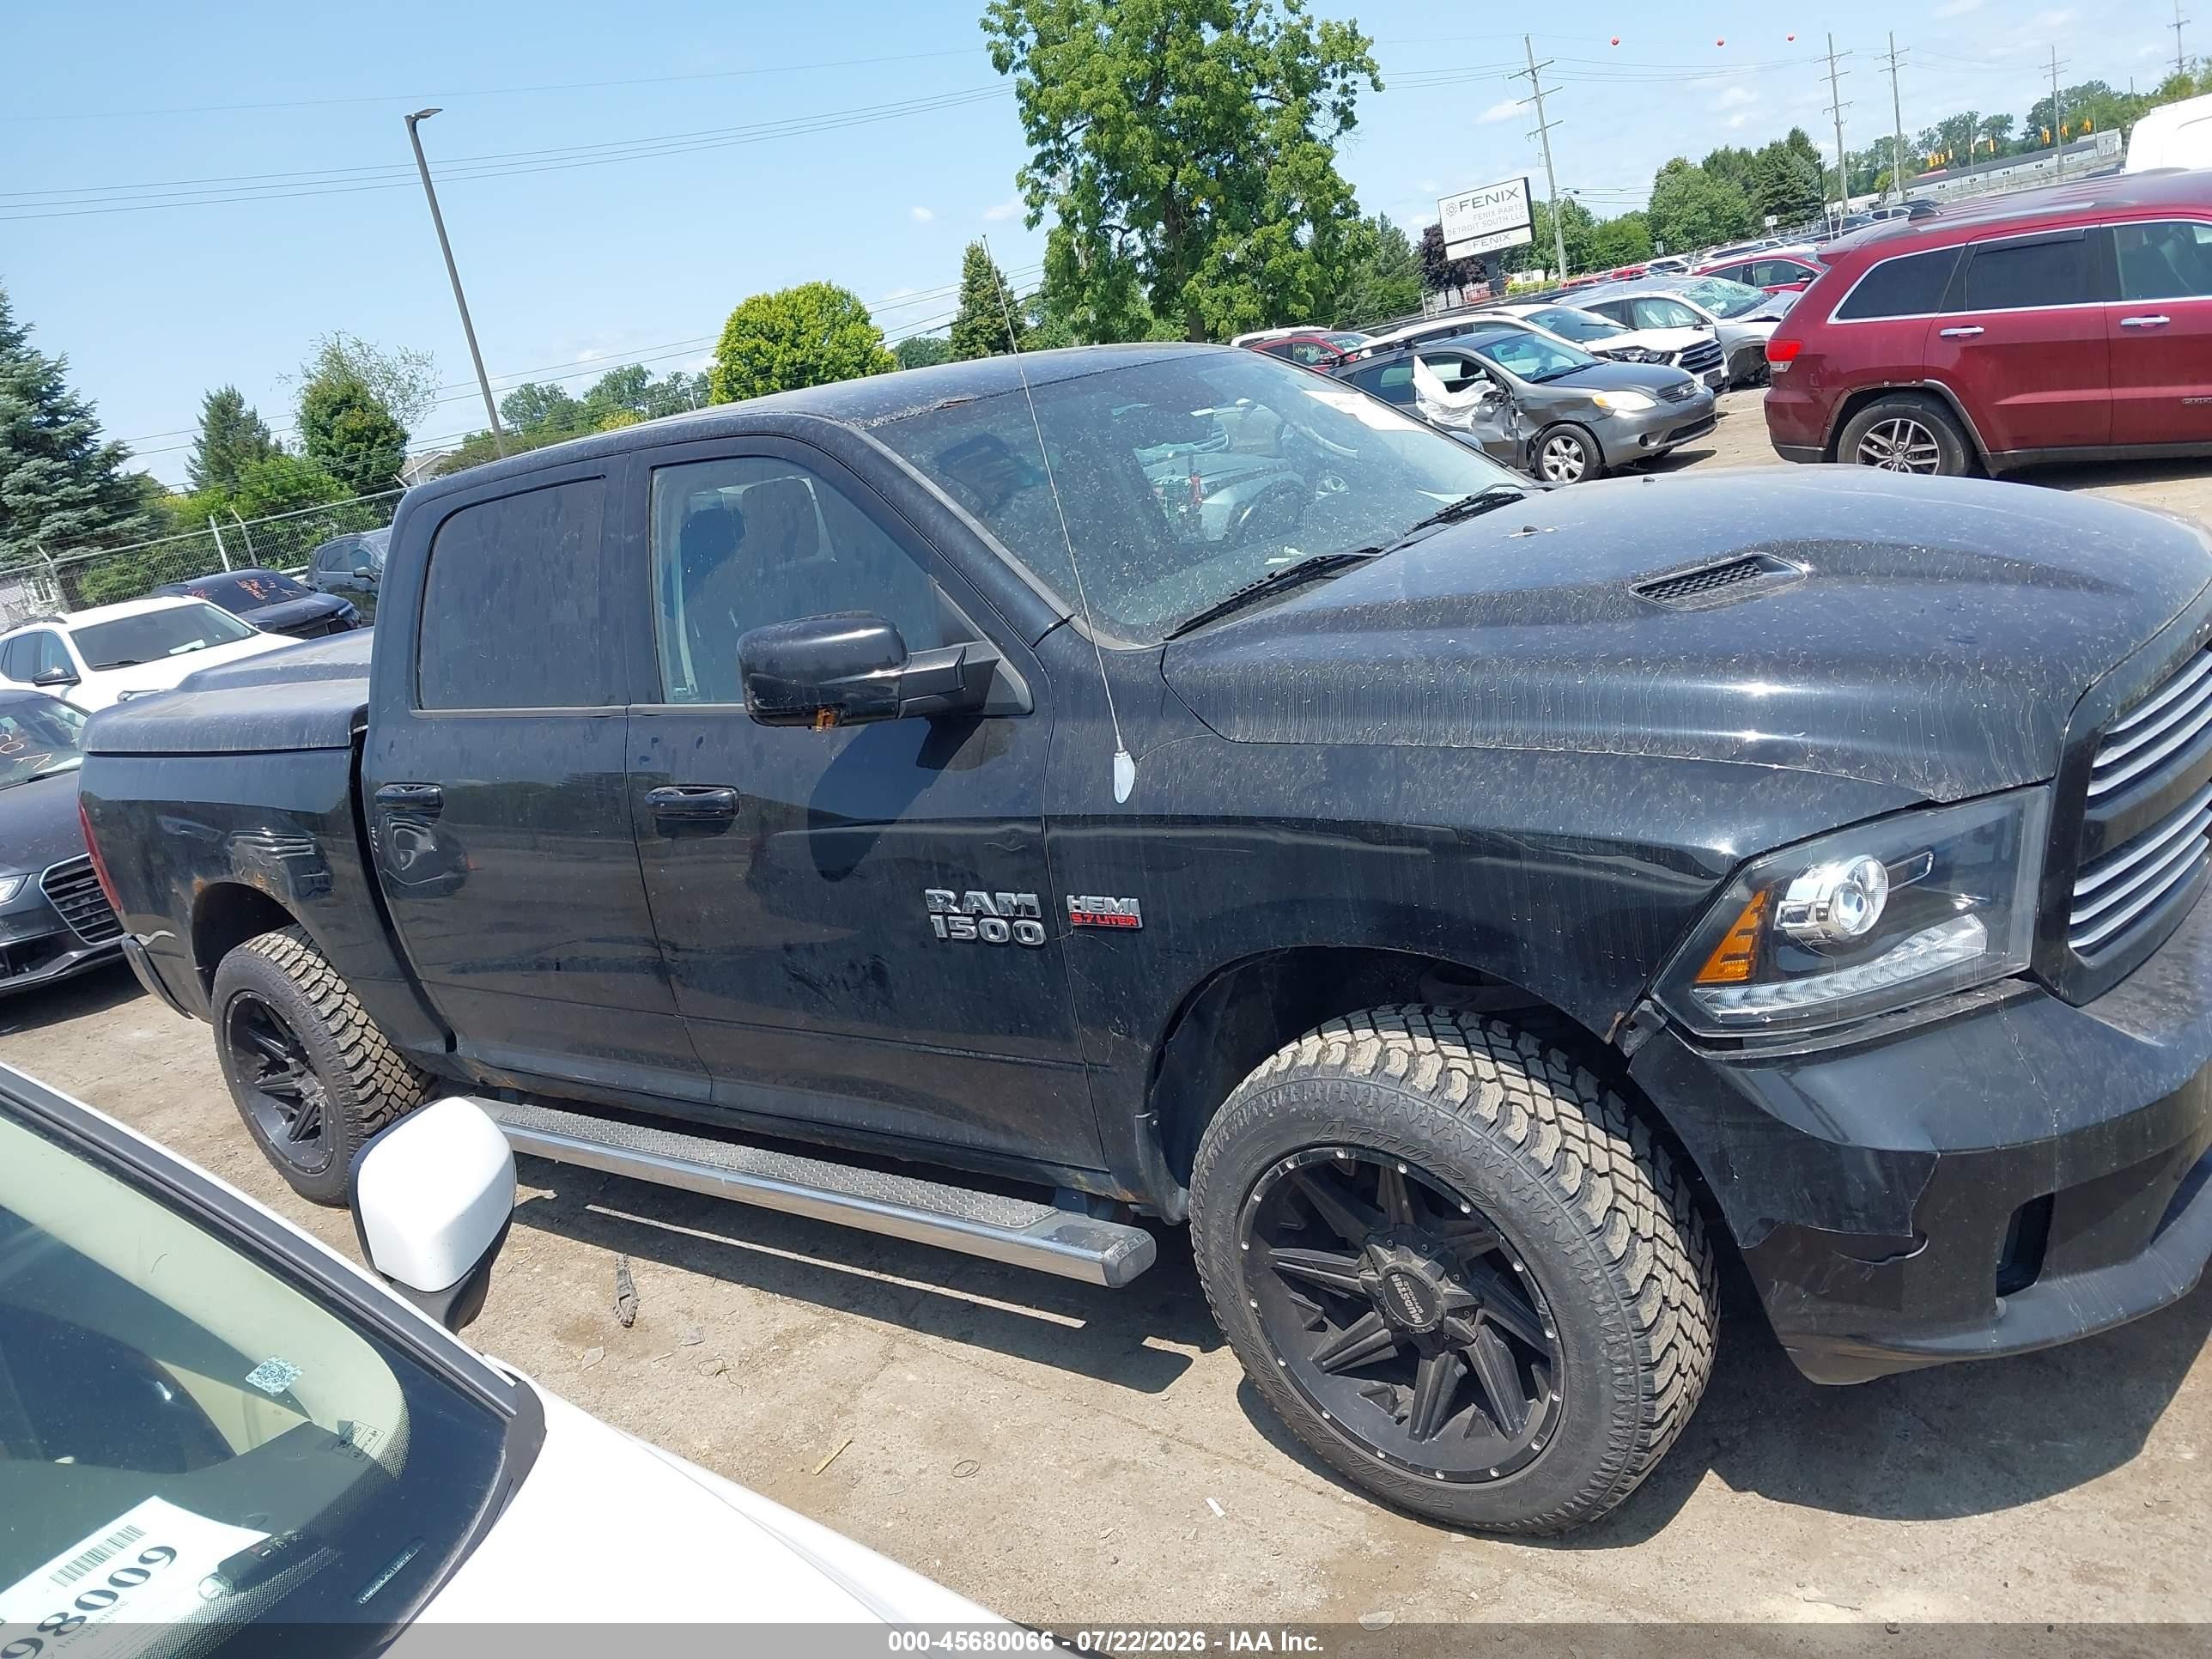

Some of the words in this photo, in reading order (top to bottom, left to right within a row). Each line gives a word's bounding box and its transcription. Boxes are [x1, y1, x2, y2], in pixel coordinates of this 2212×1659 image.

[1460, 187, 1519, 212] FENIX
[1447, 222, 1480, 236] DETROIT
[1482, 216, 1509, 228] SOUTH
[1510, 211, 1526, 221] LLC
[1473, 211, 1496, 222] FENIX
[1498, 204, 1524, 215] PARTS
[1473, 233, 1511, 249] FENIX
[924, 888, 1042, 918] RAM
[1066, 895, 1141, 915] HEMI
[930, 915, 1046, 945] 1500
[1071, 913, 1094, 924] 5.7
[1095, 915, 1138, 927] LITER
[1312, 1119, 1497, 1209] ATTURO
[1390, 1273, 1423, 1324] MUDSTER
